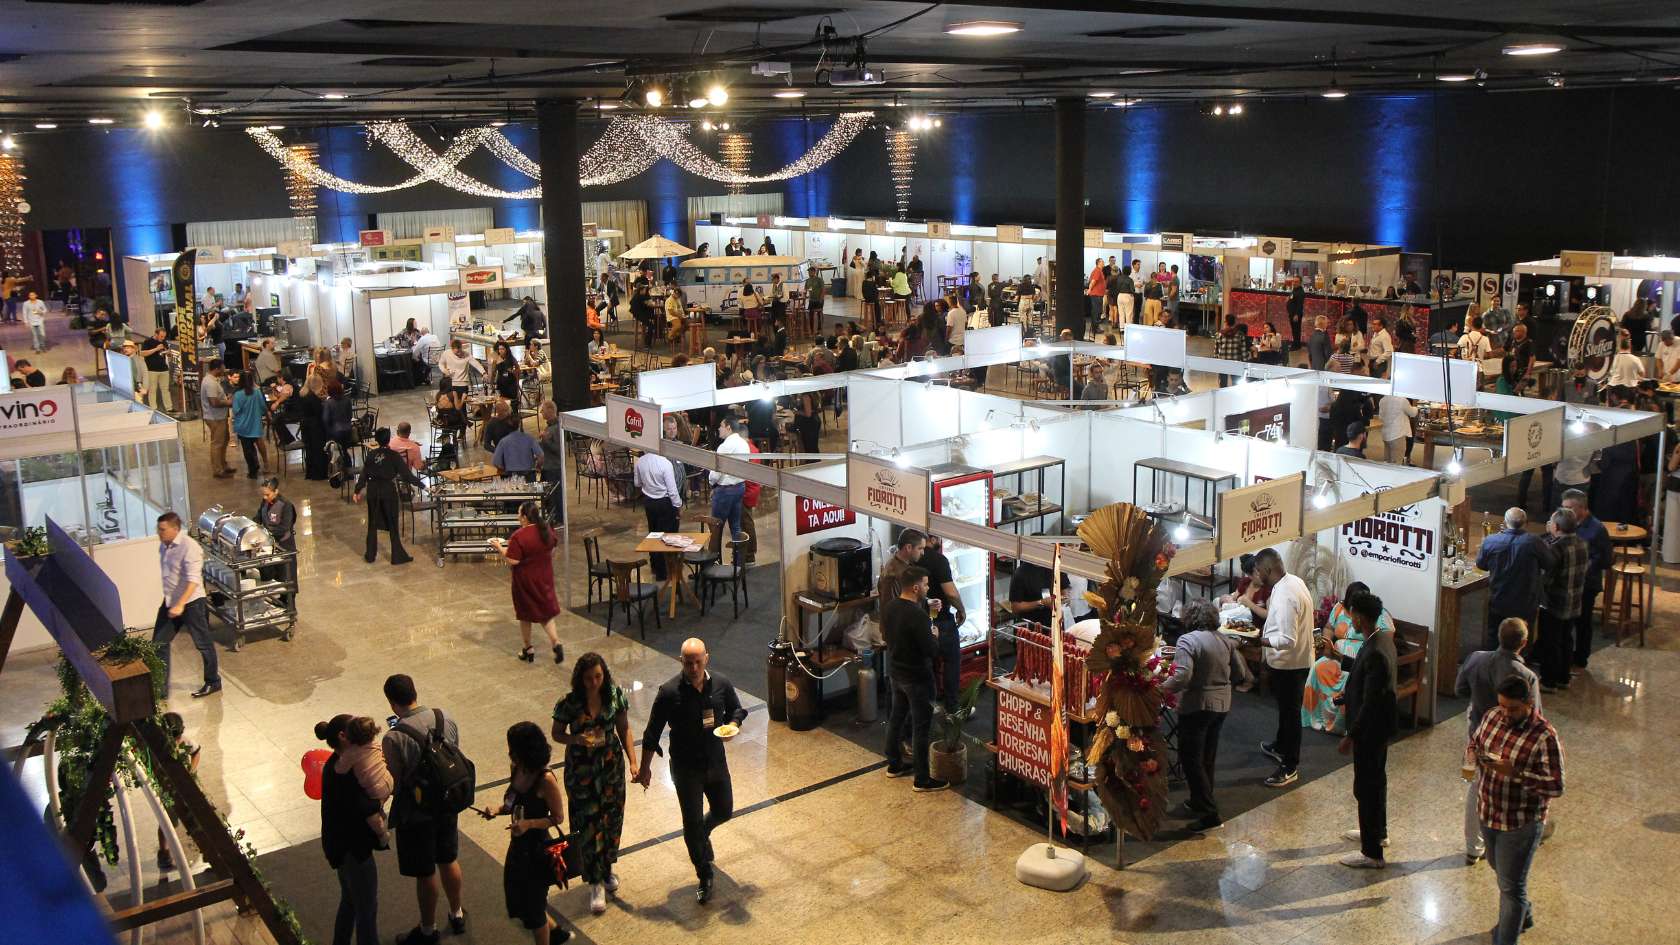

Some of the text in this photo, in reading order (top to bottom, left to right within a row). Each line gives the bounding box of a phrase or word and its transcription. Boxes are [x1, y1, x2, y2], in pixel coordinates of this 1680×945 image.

[867, 487, 907, 511] FIOROTTI
[808, 514, 819, 527] TA
[1241, 512, 1282, 538] FIOROTTI
[1342, 517, 1433, 555] FIOROTTI
[1361, 549, 1421, 569] @emporiofiorotti
[1000, 691, 1032, 717] CHOPP
[1034, 708, 1042, 720] &
[1000, 711, 1047, 744] RESENHA
[1000, 730, 1051, 766] TORRESM
